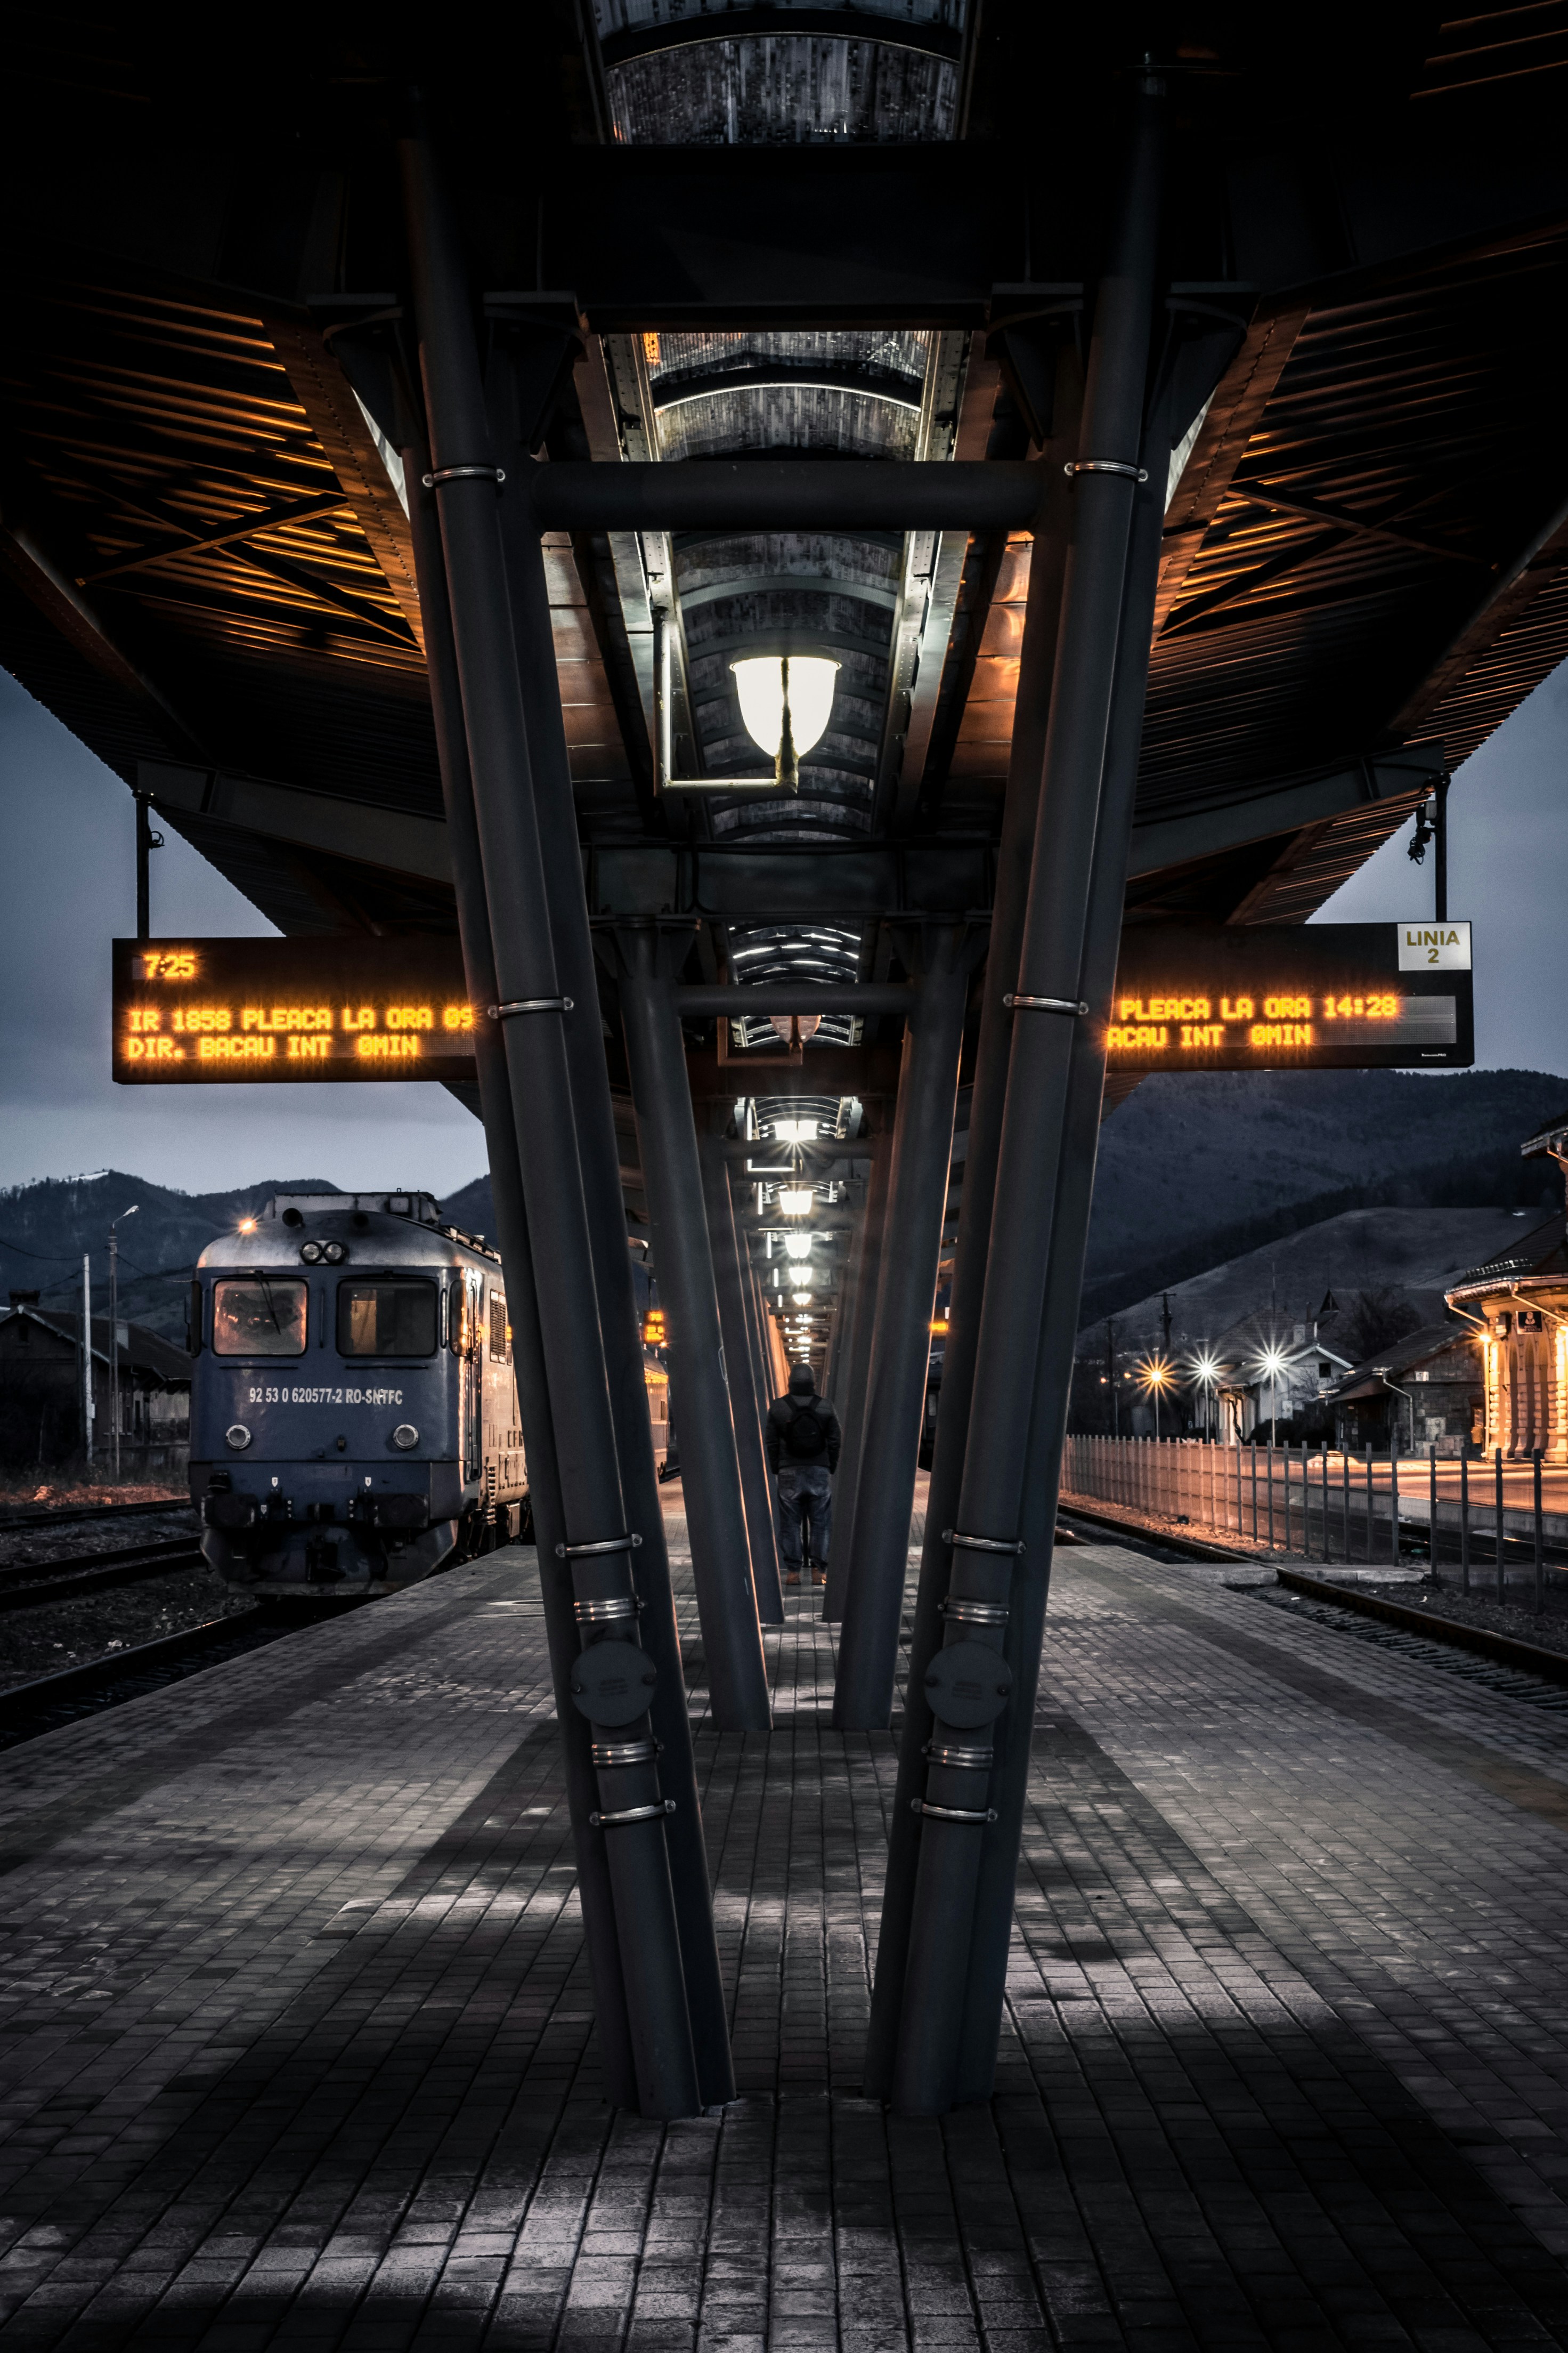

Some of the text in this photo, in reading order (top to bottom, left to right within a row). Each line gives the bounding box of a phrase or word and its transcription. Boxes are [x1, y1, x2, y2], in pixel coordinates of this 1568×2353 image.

[1407, 931, 1460, 946] LINIA
[145, 955, 194, 978] 7:25
[1428, 948, 1439, 964] 2
[131, 1006, 474, 1032] IR 1858 PLEACA LA ORA 09
[1120, 996, 1399, 1020] PLEACA LA ORA 14:28
[127, 1037, 185, 1058] DIR.
[198, 1037, 275, 1059] BACAU
[288, 1036, 331, 1058] INT
[1107, 1026, 1167, 1048] ACAU
[1182, 1025, 1224, 1047] INT
[249, 1387, 403, 1405] 92 53 0 620577-2 RO-SNTFC
